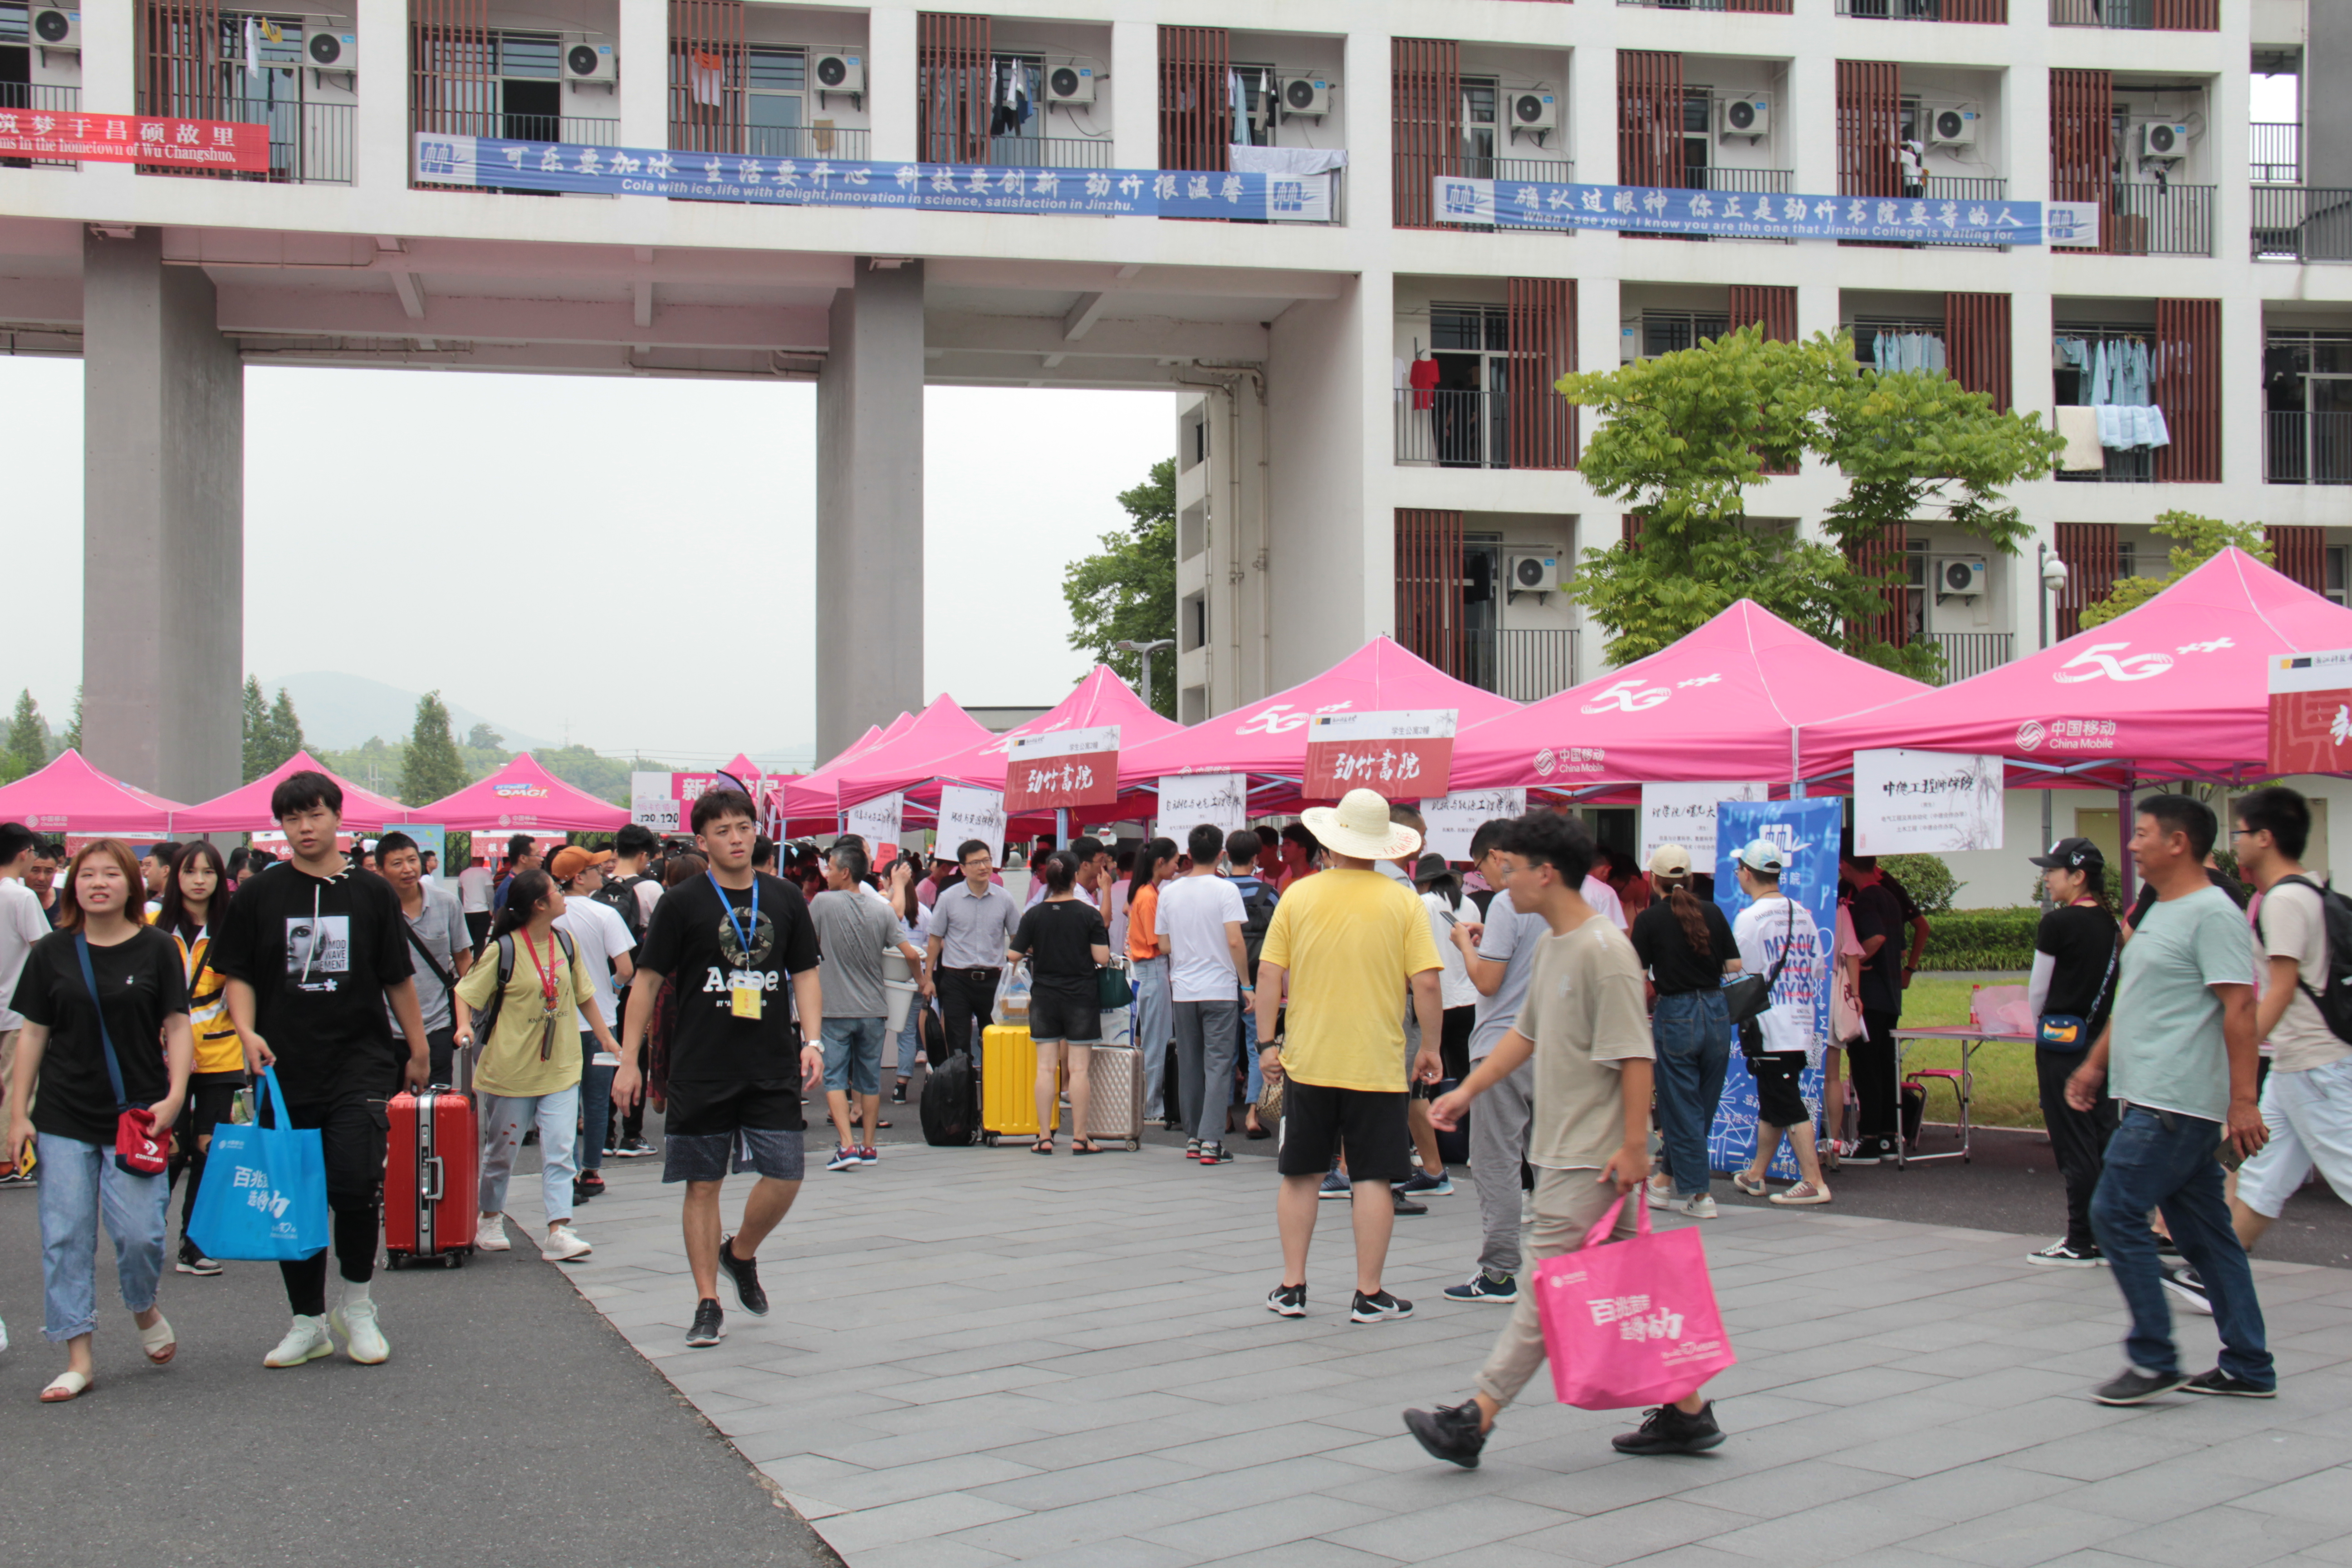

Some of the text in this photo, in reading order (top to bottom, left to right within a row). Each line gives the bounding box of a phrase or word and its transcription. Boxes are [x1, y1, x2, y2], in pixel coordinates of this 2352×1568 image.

[0, 113, 235, 146] 筑梦于昌硕故里
[19, 135, 33, 150] in
[36, 137, 57, 152] the
[59, 138, 123, 156] hometown
[126, 142, 140, 157] of
[143, 143, 162, 157] Wu
[622, 178, 654, 191] Cola
[658, 181, 687, 193] with
[744, 186, 773, 198] with
[908, 192, 921, 204] in
[924, 194, 982, 209] science,
[985, 196, 1067, 210] satisfaction
[1070, 198, 1083, 210] in
[1085, 198, 1134, 211] Jinzhu.
[1514, 185, 2023, 229] 确认过眼神 你正是劲竹书院要等的人
[1523, 211, 1561, 224] When
[1574, 216, 1599, 225] see
[1644, 217, 1680, 229] know
[1684, 219, 1709, 232] you
[1713, 221, 1735, 231] are
[1738, 220, 1760, 231] the
[1764, 223, 1788, 234] one
[1792, 224, 1820, 235] that
[1823, 225, 1867, 236] Jinzhu
[1872, 225, 1924, 240] College
[1926, 227, 1939, 238] is
[1942, 229, 1990, 242] waiting
[2050, 719, 2116, 737] 中国移动
[2049, 737, 2114, 749] China Mobile
[1559, 748, 1605, 762] 中国移动
[1559, 762, 1605, 774] China Mobile
[661, 813, 678, 823] 120
[328, 940, 347, 949] MOD
[325, 950, 346, 959] WAVE
[135, 1153, 163, 1163] CONVERSE
